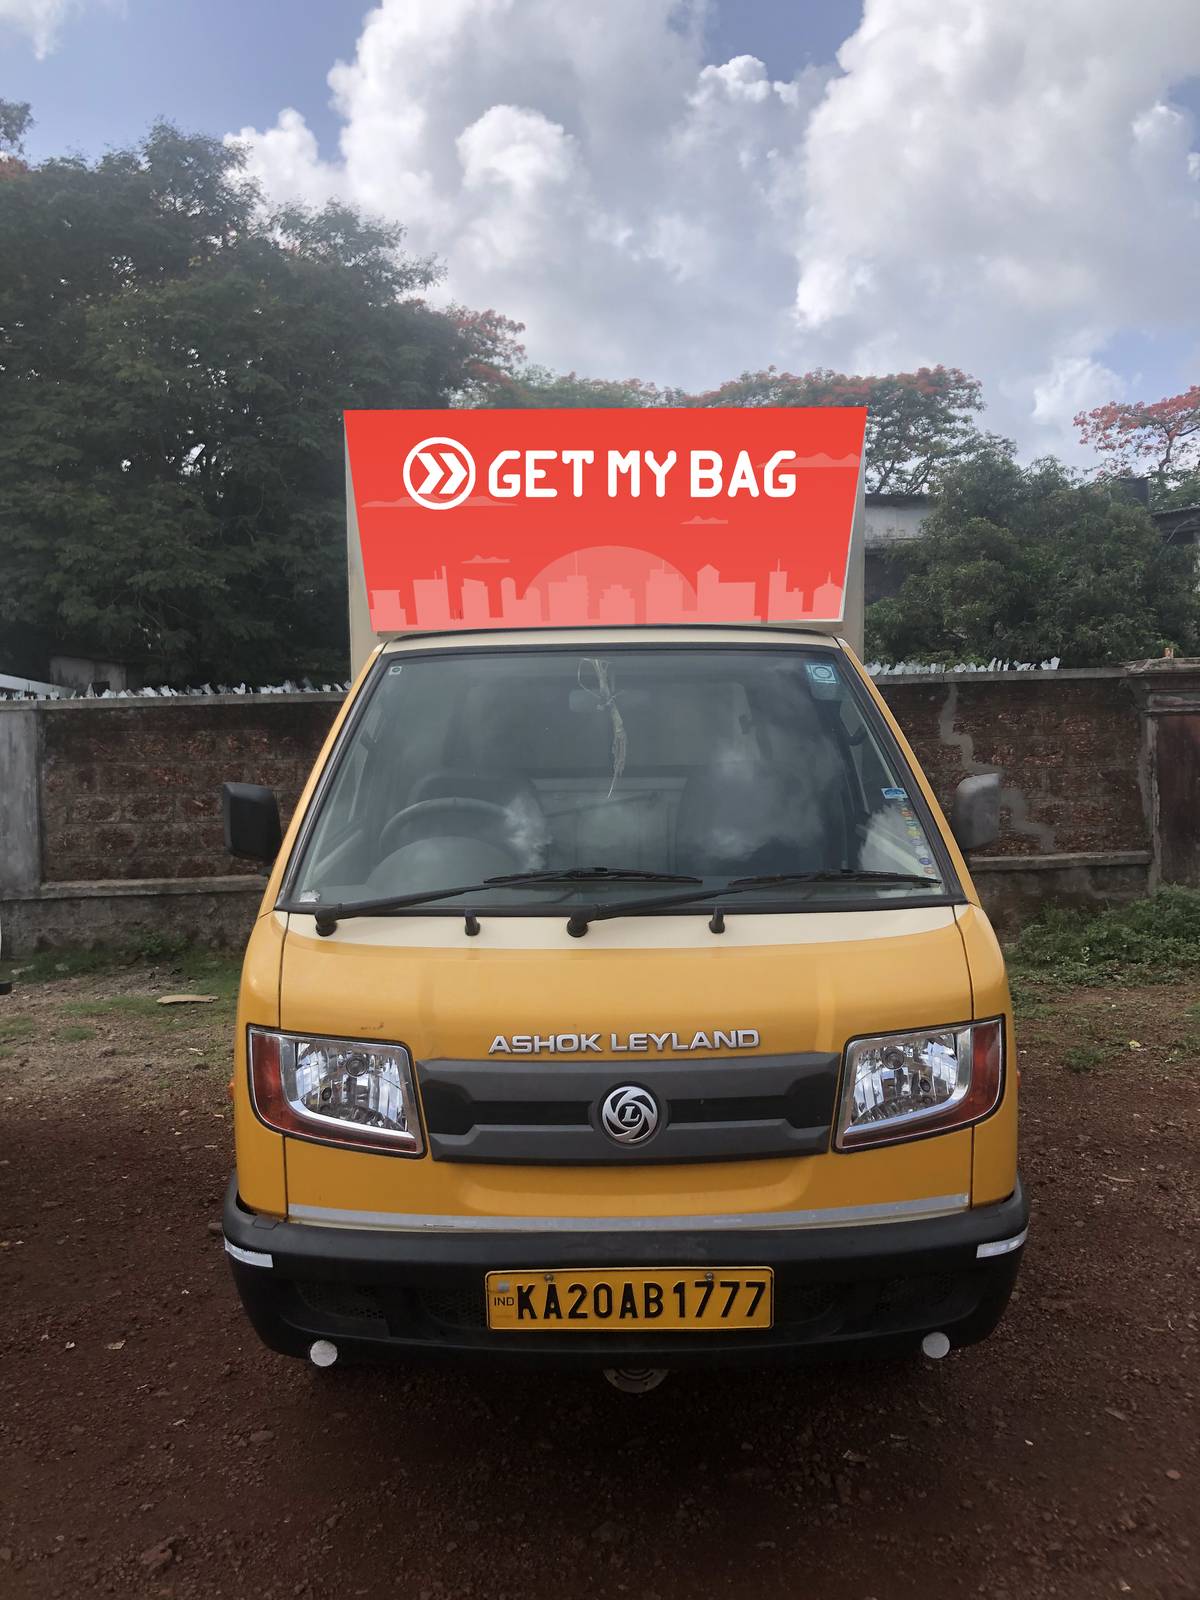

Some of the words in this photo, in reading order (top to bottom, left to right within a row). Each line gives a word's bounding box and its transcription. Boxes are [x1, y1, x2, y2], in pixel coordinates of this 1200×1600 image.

[488, 450, 595, 498] GET
[607, 450, 677, 498] MY
[690, 450, 797, 498] BAG
[489, 1033, 602, 1053] ASHOK
[611, 1029, 760, 1050] LEYLAND
[622, 1105, 640, 1122] L
[493, 1296, 515, 1307] IND
